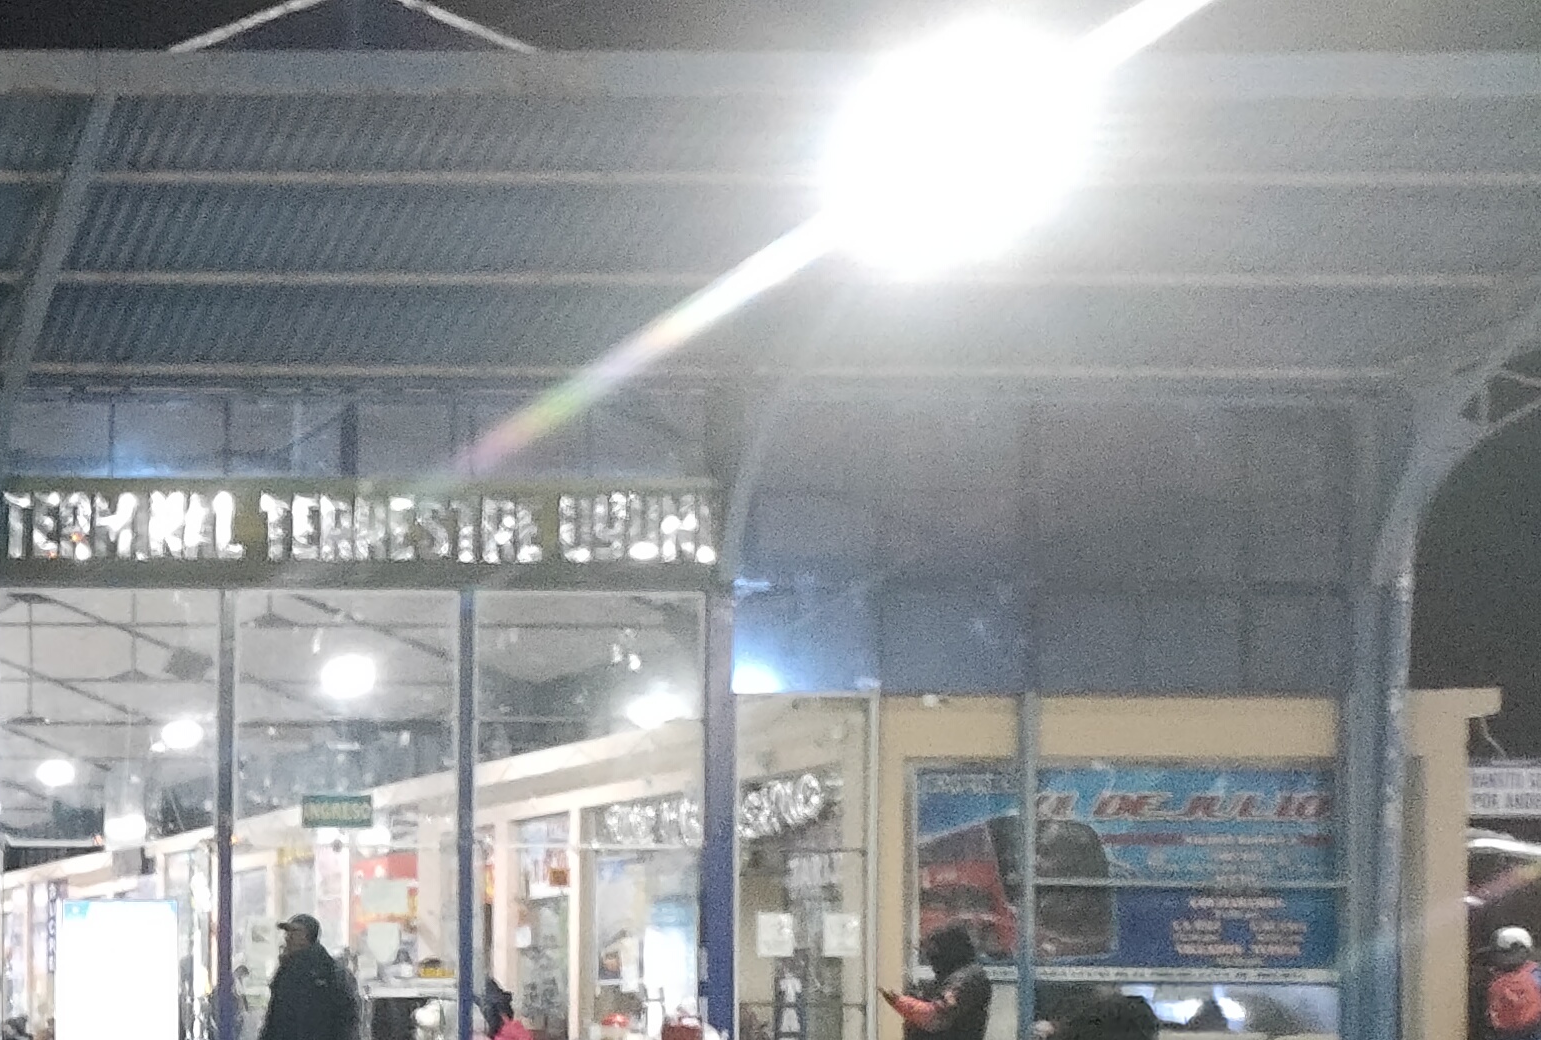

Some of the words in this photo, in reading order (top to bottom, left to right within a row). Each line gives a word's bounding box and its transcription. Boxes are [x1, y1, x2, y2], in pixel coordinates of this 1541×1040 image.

[3, 490, 244, 559] TERMINAL
[259, 493, 543, 564] TERRESTRE
[558, 490, 716, 565] UYUNI
